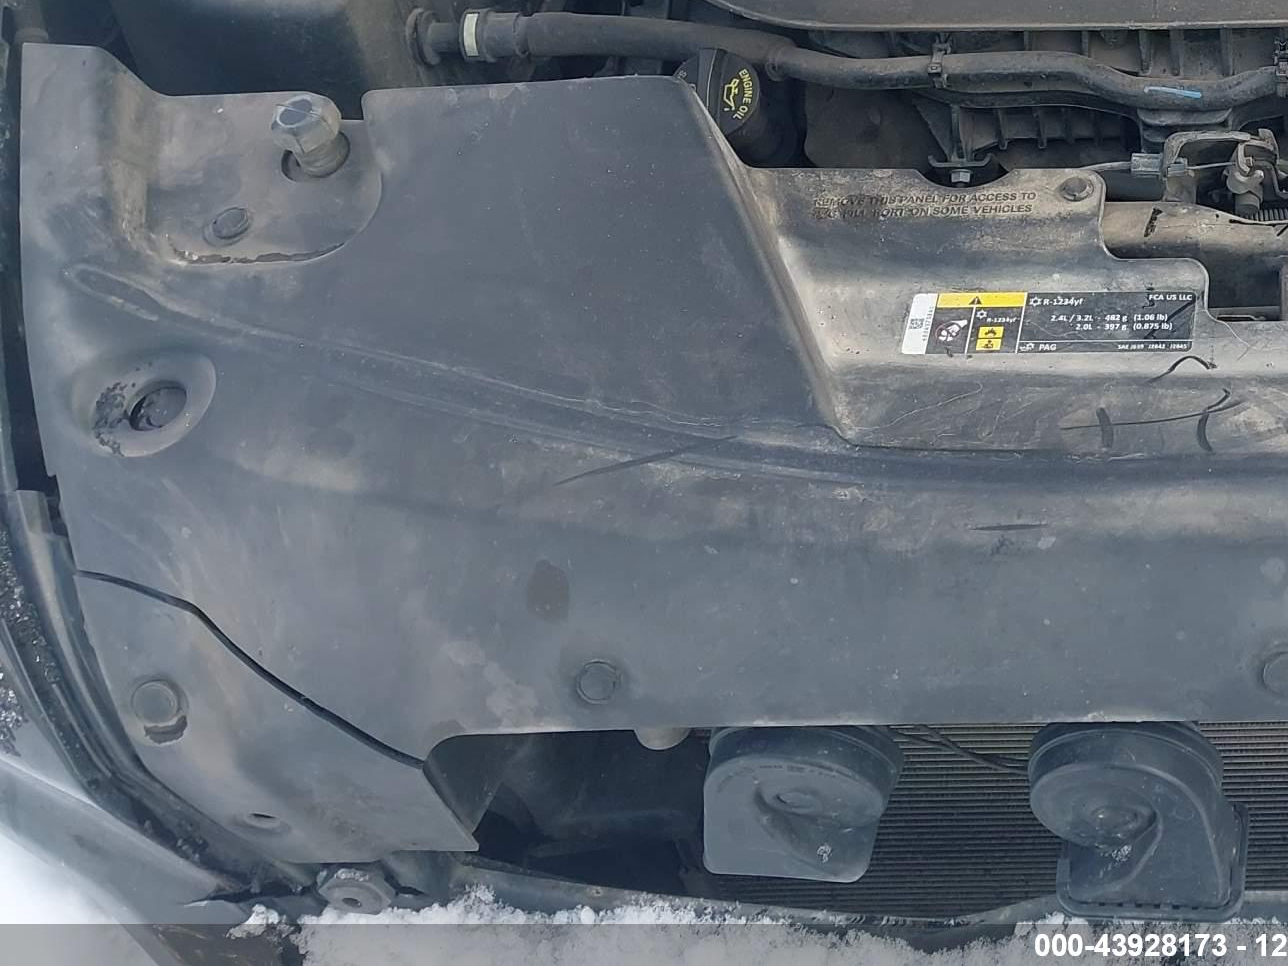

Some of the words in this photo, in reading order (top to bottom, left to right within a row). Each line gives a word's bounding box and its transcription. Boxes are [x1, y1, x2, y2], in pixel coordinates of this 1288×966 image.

[739, 69, 753, 104] ENGINE
[732, 105, 748, 120] OIL
[899, 194, 938, 204] PANEL
[941, 194, 966, 203] FOR
[969, 192, 1017, 203] ACCESS
[1020, 192, 1037, 201] TO
[911, 207, 929, 216] ON
[932, 206, 968, 215] SOME
[973, 204, 1033, 214] VEHICLES
[1043, 297, 1083, 307] R-1234yf
[1050, 314, 1068, 322] 2.4L
[1076, 314, 1094, 322] 3.2L
[1121, 315, 1128, 323] g
[1039, 343, 1057, 351] PAG
